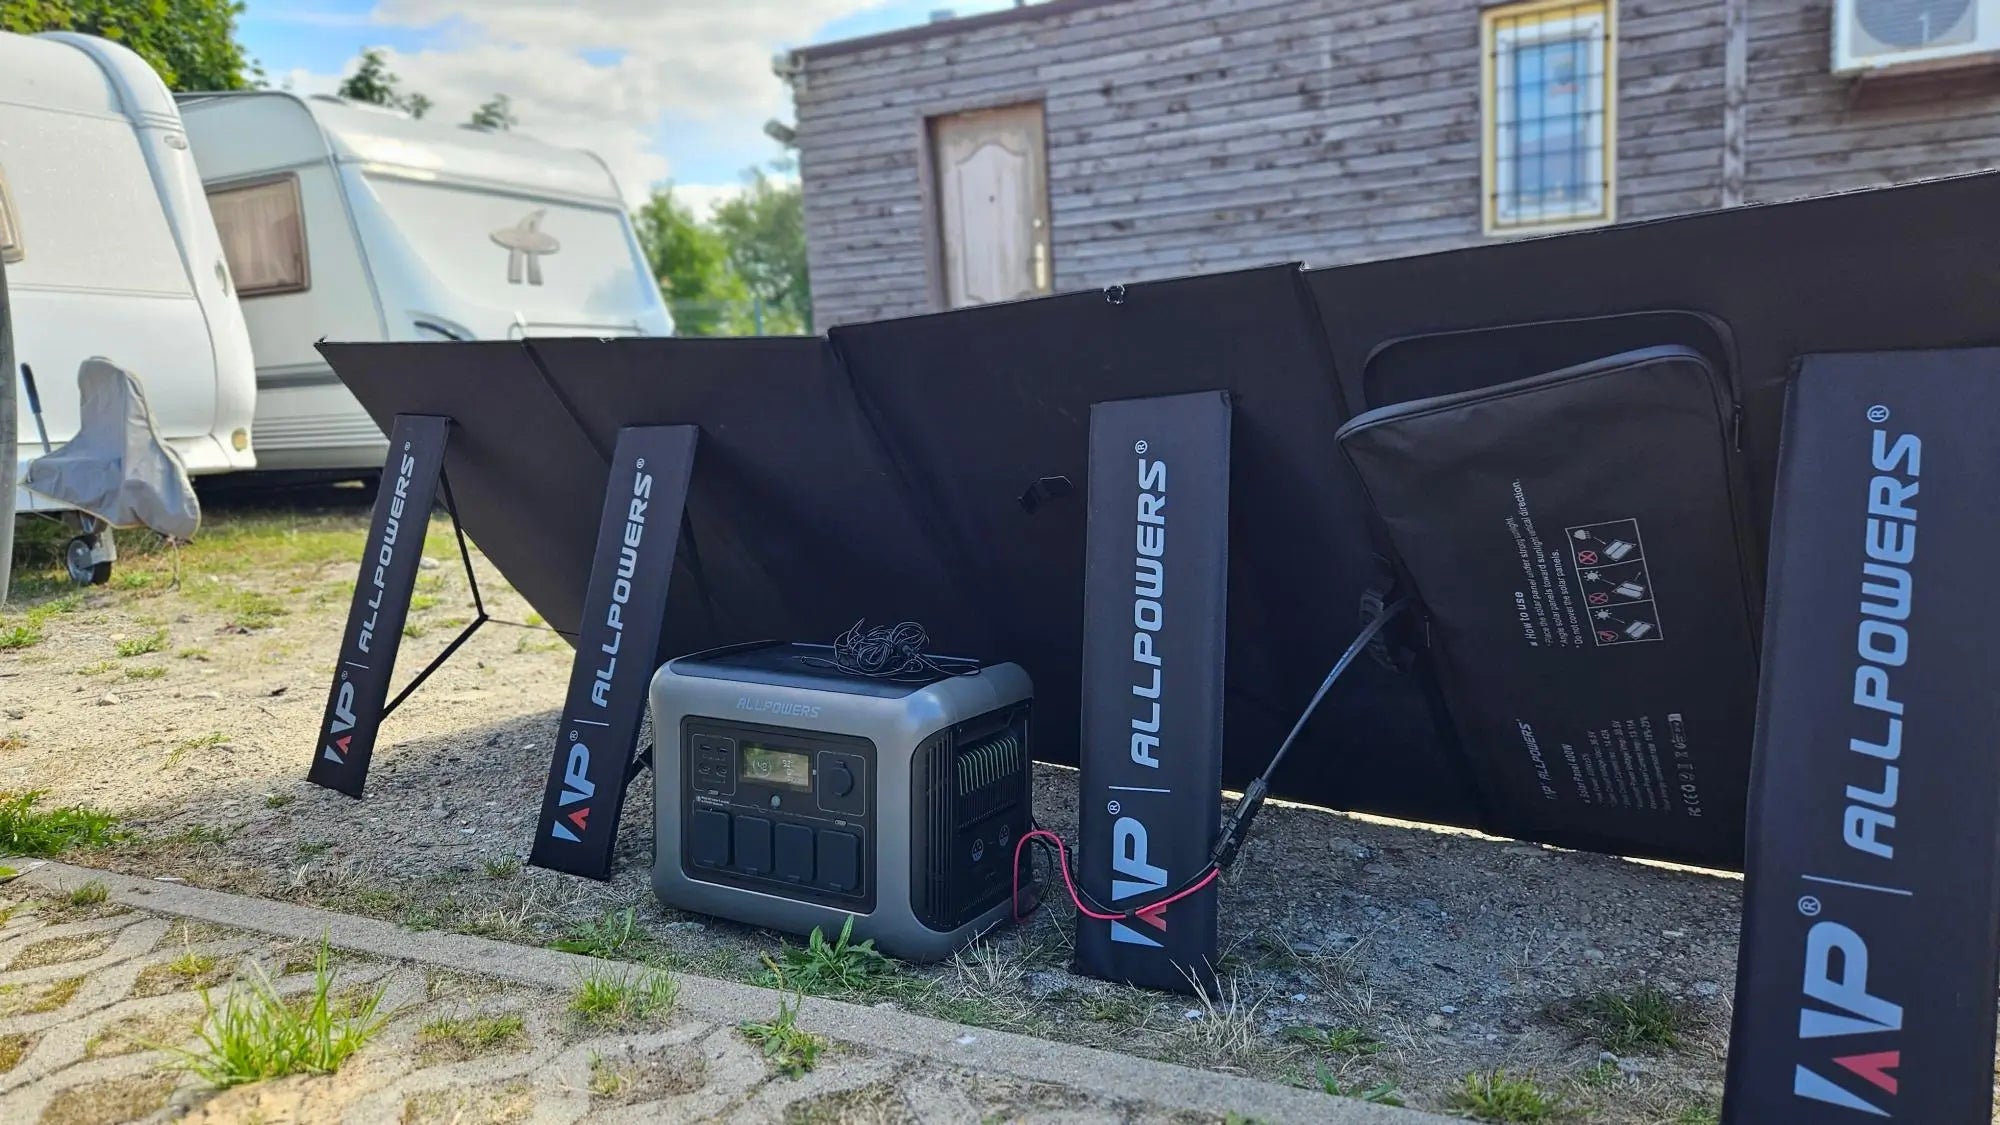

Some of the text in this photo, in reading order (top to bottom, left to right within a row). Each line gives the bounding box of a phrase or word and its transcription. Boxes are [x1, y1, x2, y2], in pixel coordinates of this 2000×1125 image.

[1536, 564, 1550, 588] toward
[1557, 577, 1569, 595] solar
[1533, 600, 1545, 616] solar
[1544, 588, 1559, 611] panels
[1514, 591, 1537, 640] How to use
[1551, 611, 1563, 627] solar
[1574, 635, 1583, 645] Do
[736, 697, 822, 719] ALLPOWERS
